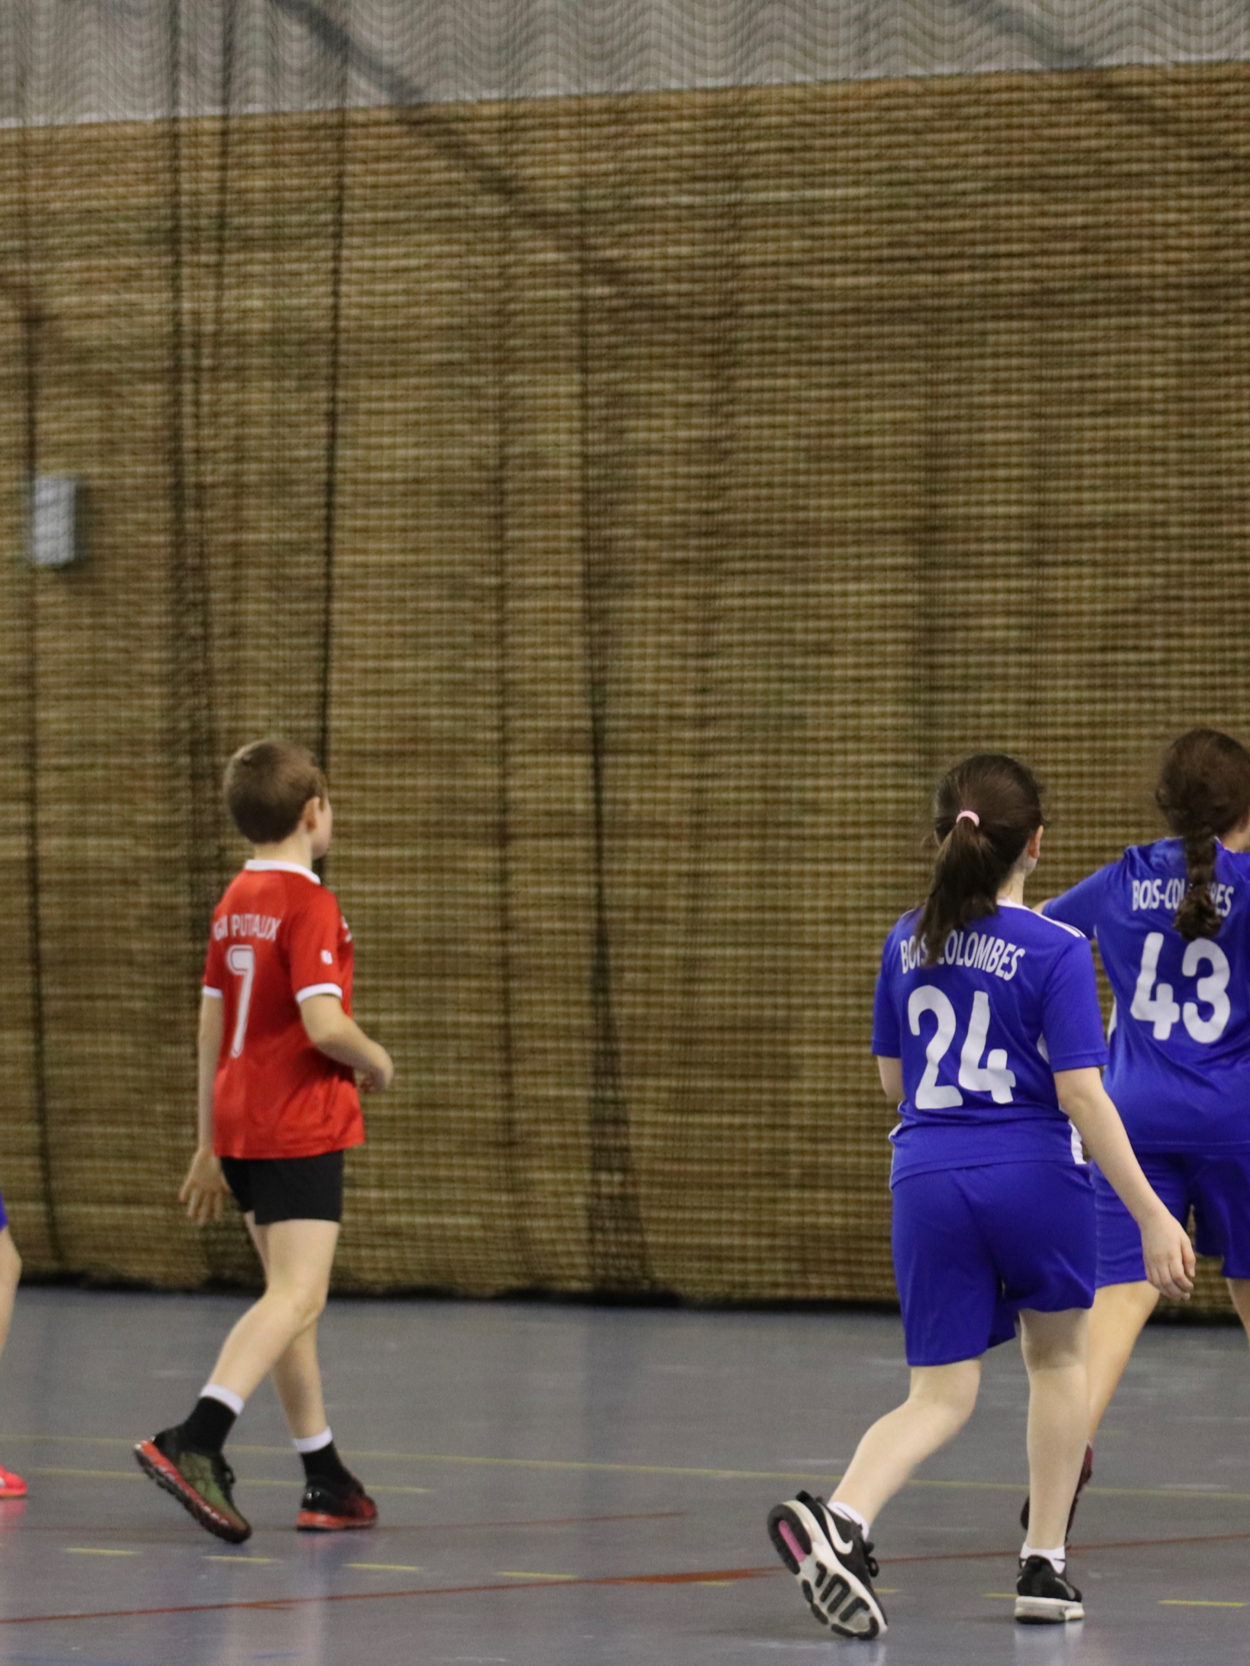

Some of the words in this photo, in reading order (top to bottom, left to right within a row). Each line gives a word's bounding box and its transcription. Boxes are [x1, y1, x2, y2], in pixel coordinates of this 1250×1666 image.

[226, 944, 256, 1058] 7
[1130, 932, 1231, 1044] 43
[907, 985, 1016, 1110] 24
